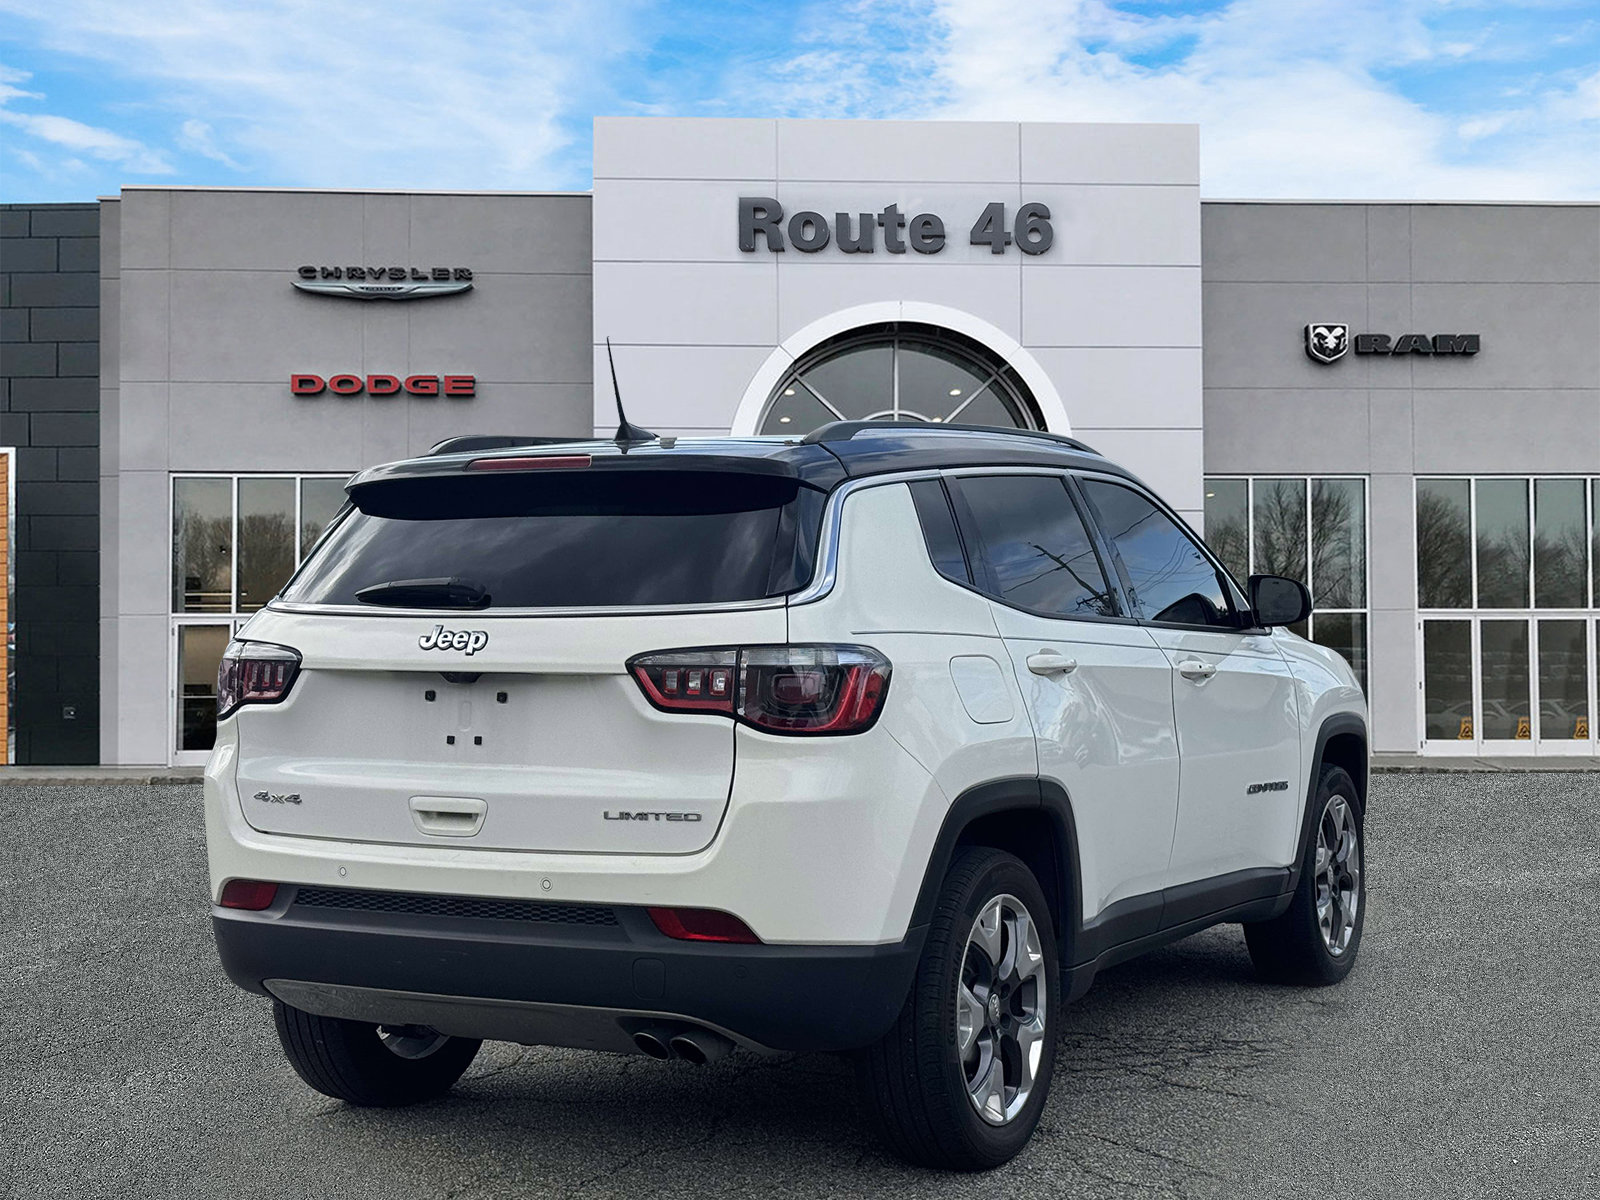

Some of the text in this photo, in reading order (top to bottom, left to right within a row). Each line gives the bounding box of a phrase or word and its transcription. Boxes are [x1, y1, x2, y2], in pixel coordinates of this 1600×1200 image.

[738, 196, 1054, 255] Route 46
[298, 266, 473, 281] CHRYSLER
[1354, 334, 1480, 355] RAM
[291, 374, 476, 397] DODGE
[419, 624, 489, 656] Jeep
[253, 790, 303, 805] 4x4
[603, 811, 702, 822] LIMITED
